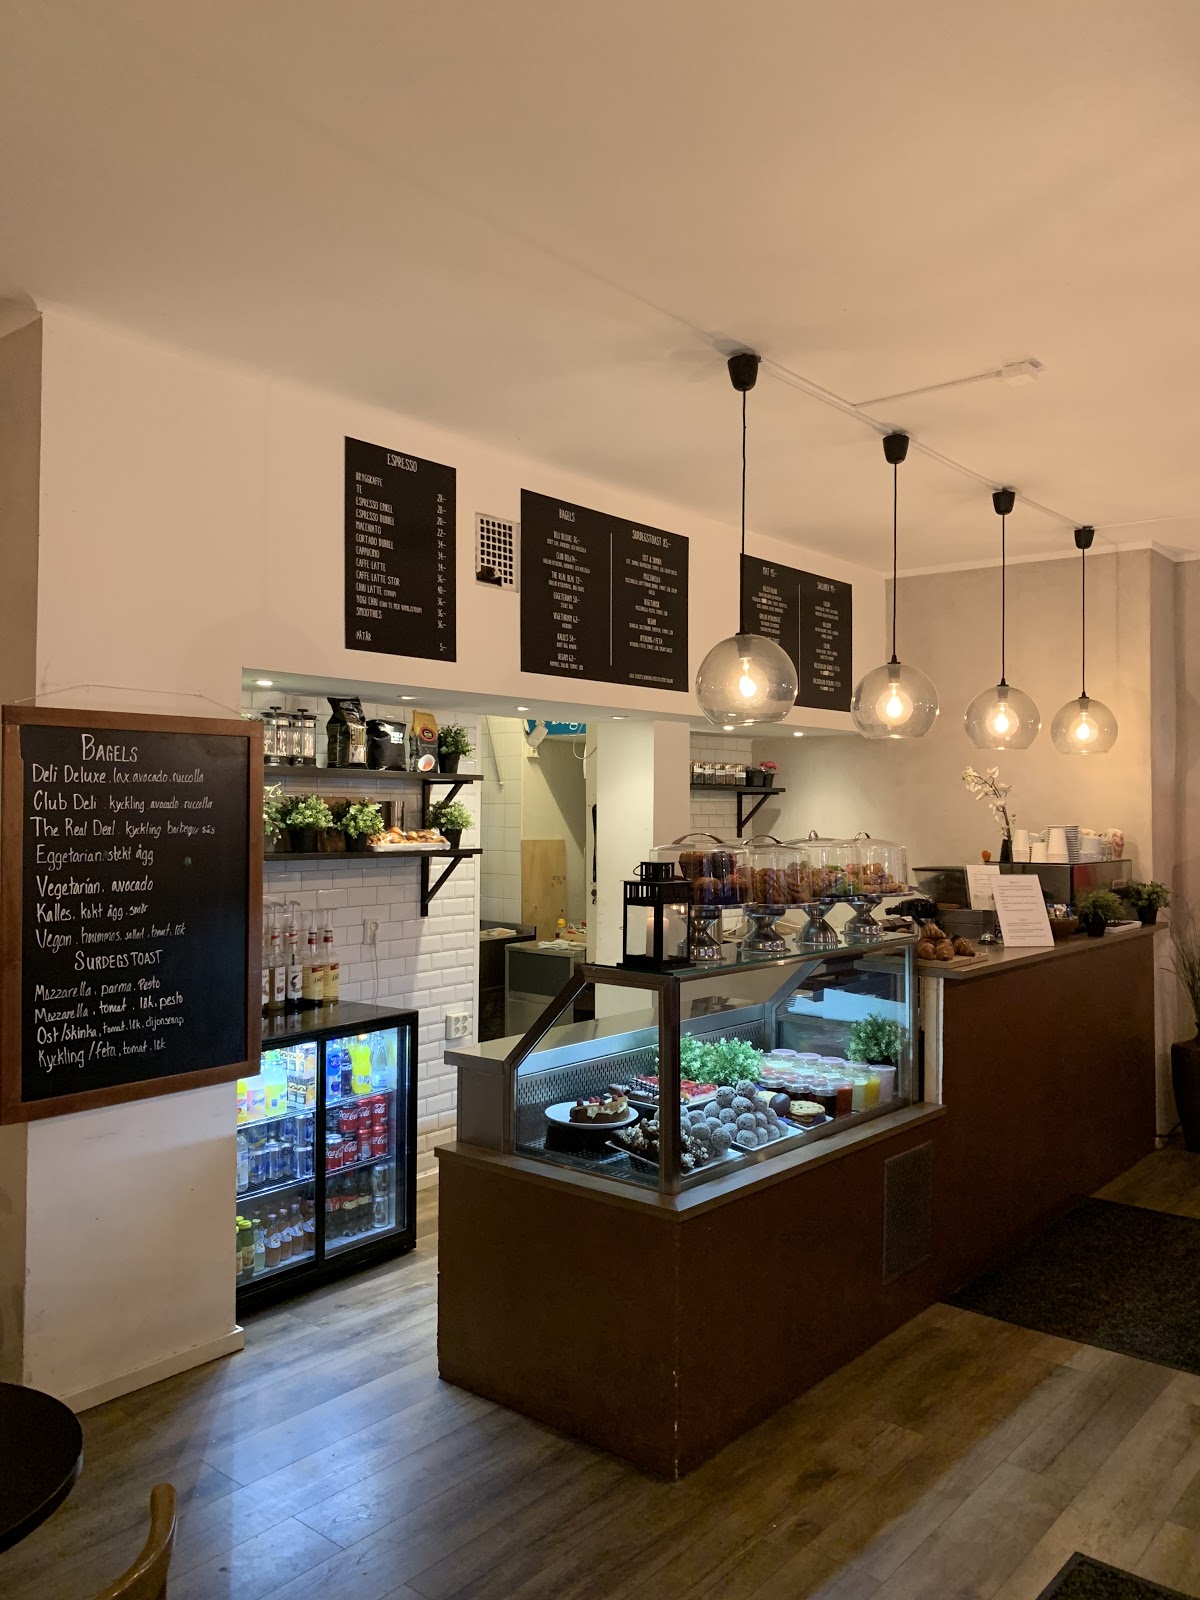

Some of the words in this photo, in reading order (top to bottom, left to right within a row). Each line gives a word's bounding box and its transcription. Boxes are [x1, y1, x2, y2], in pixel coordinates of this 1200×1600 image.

[387, 453, 418, 472] ESPRESSO
[356, 484, 362, 494] TE
[356, 496, 378, 510] ESPRESSO
[356, 509, 378, 522] ESPRESSO
[559, 508, 576, 522] BAGELS
[356, 534, 377, 546] CORTADO
[356, 558, 370, 569] CAFFE
[371, 561, 386, 572] LATTE
[356, 570, 370, 581] CAFFE
[371, 574, 386, 584] LATTE
[388, 576, 400, 586] STOR
[367, 585, 382, 596] LATTE
[356, 606, 382, 619] SMOOTHIES
[356, 630, 372, 641] PÅTÅR
[81, 733, 137, 762] BAGELS
[32, 763, 58, 782] Deli
[64, 764, 106, 783] Deluxe
[33, 790, 67, 810] Club
[73, 793, 97, 810] Deli
[110, 795, 145, 813] kyckling
[30, 816, 59, 837] The
[65, 818, 88, 836] Real
[126, 821, 161, 838] kyckling
[112, 875, 154, 892] avocado
[81, 902, 103, 919] kokt
[36, 929, 72, 954] Vegan
